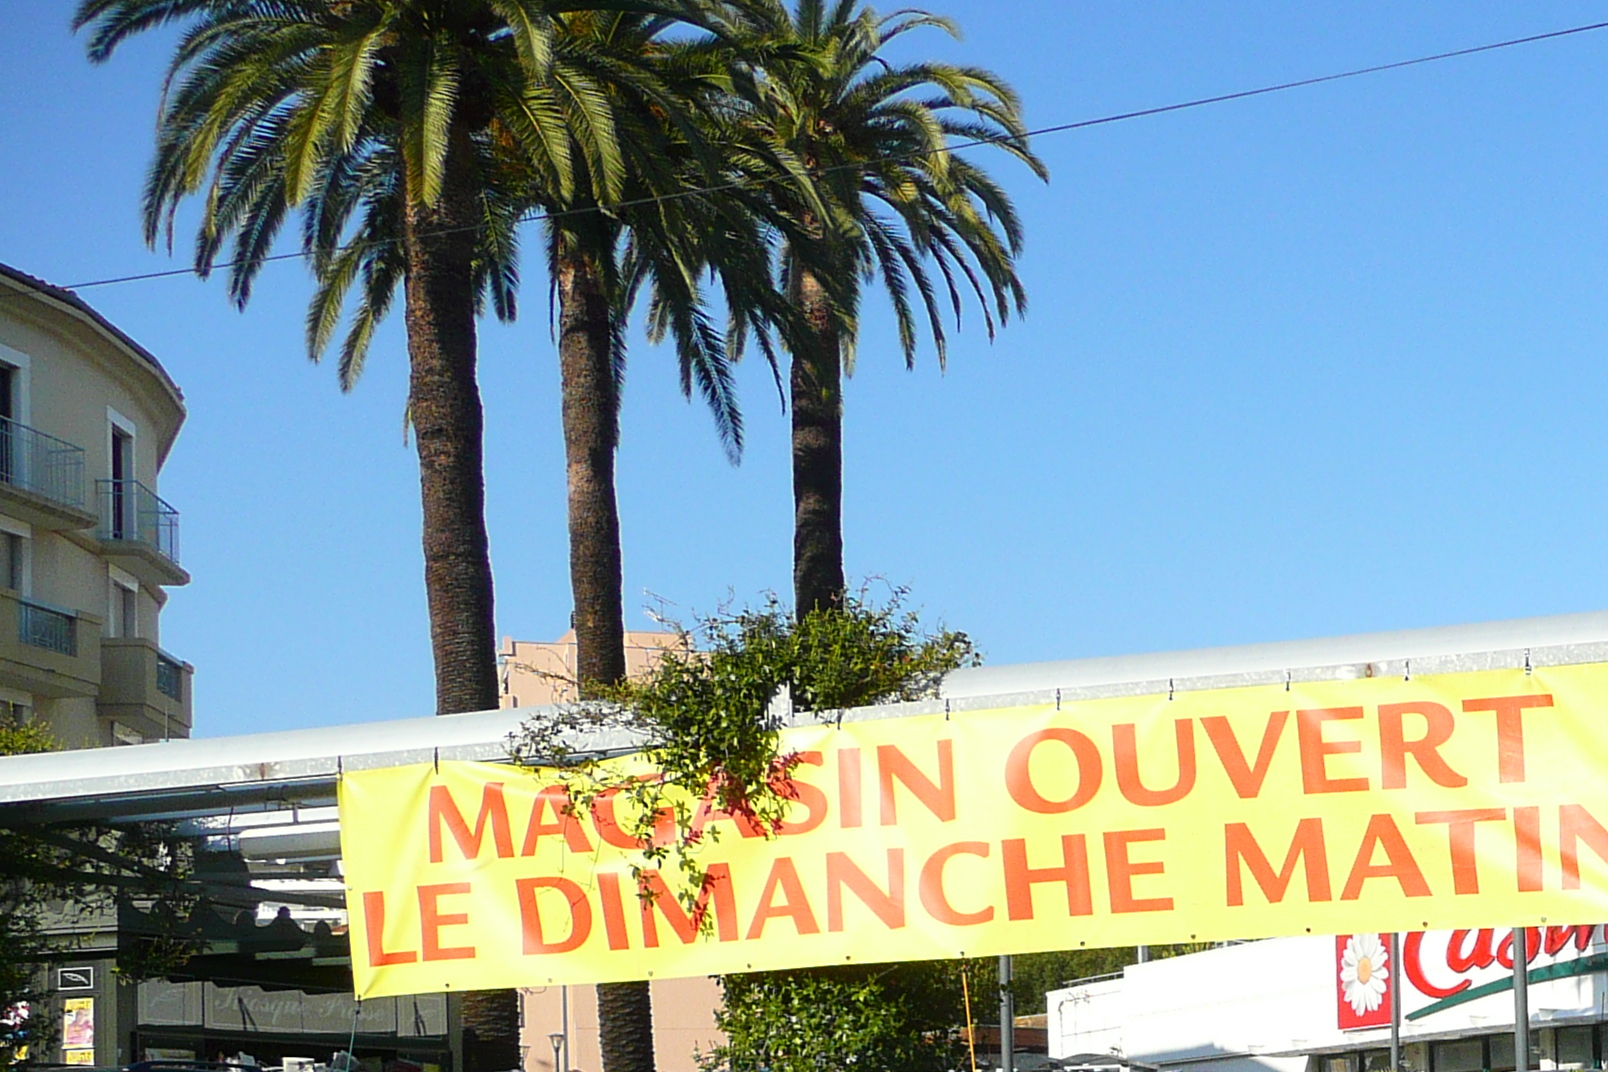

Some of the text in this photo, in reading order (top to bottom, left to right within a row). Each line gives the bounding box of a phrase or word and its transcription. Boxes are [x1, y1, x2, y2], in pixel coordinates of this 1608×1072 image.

[428, 694, 1554, 864] MAGASIN OUVERT
[362, 882, 476, 968] LE
[515, 827, 1175, 957] DIMANCHE
